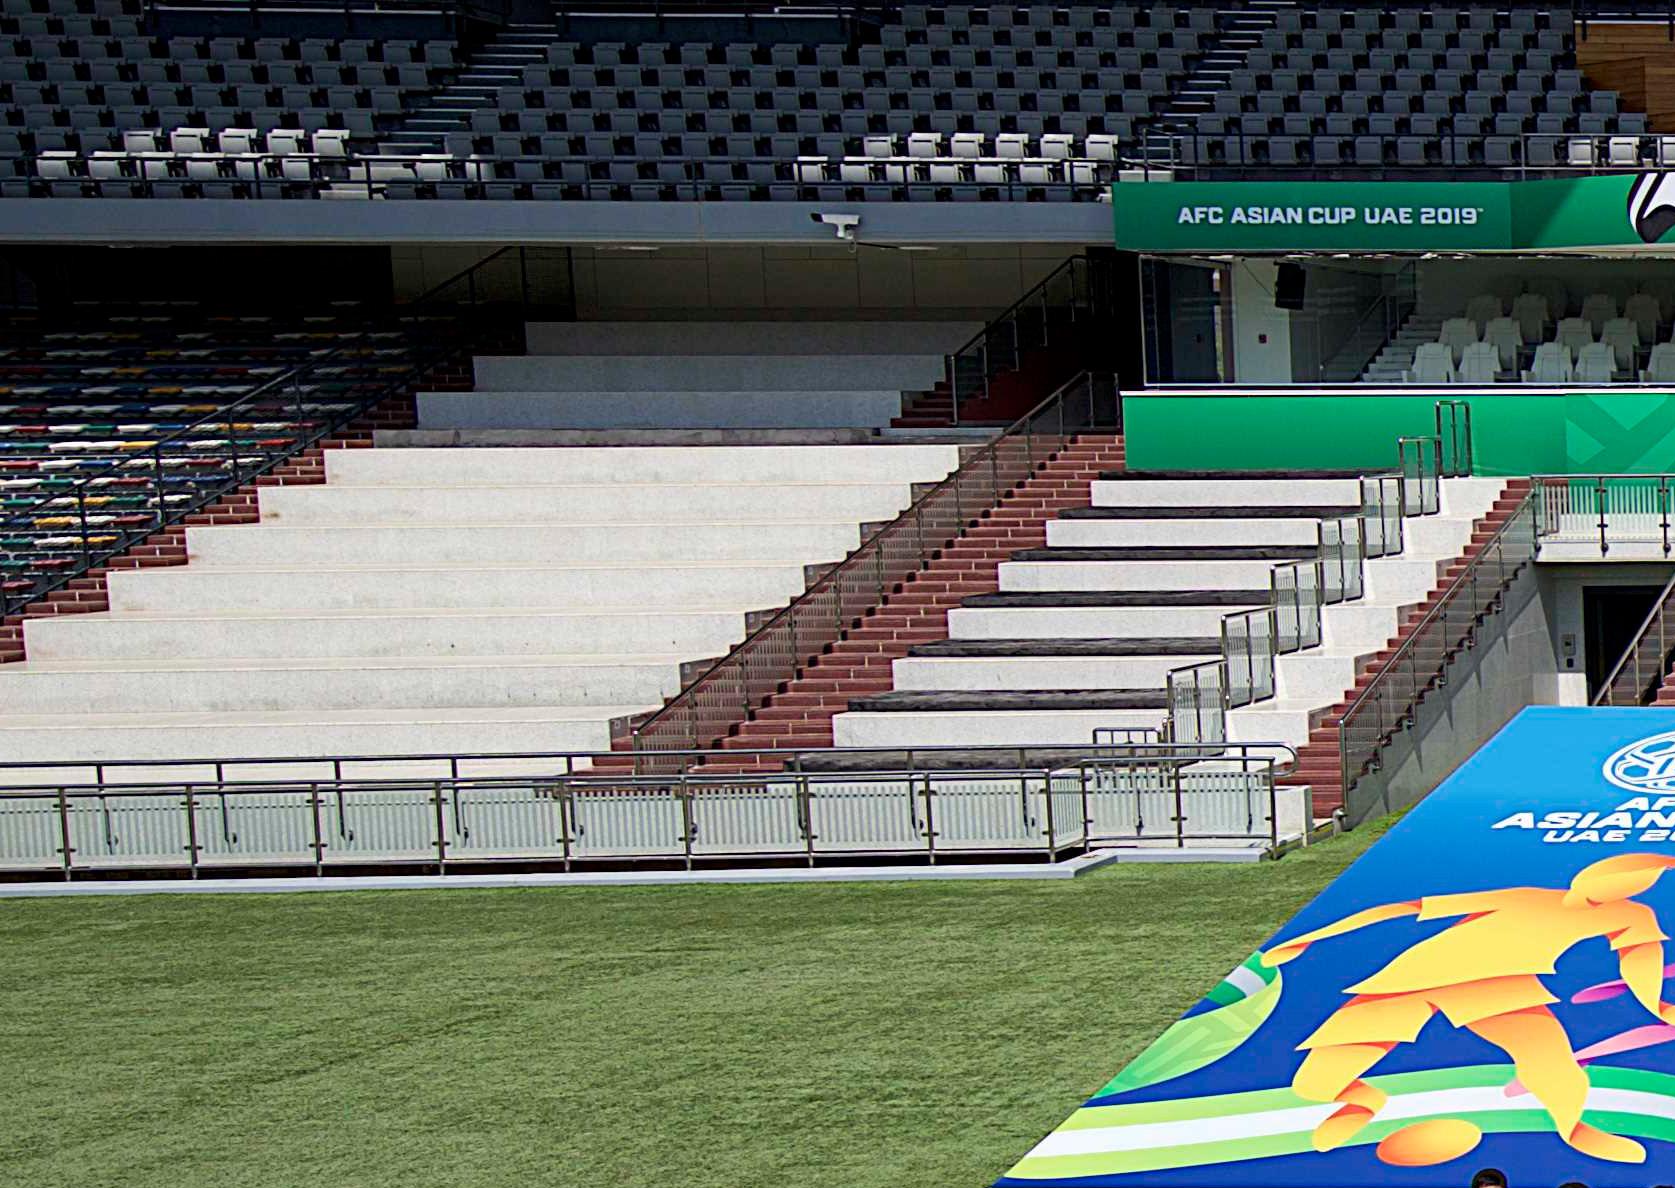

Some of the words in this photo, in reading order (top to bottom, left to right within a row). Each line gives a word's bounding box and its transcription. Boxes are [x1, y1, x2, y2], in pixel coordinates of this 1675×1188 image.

[1179, 207, 1223, 223] AFC
[1231, 207, 1302, 224] ASIAN
[1308, 208, 1355, 224] CUP
[1365, 208, 1412, 224] UAE
[1543, 829, 1631, 843] UAE
